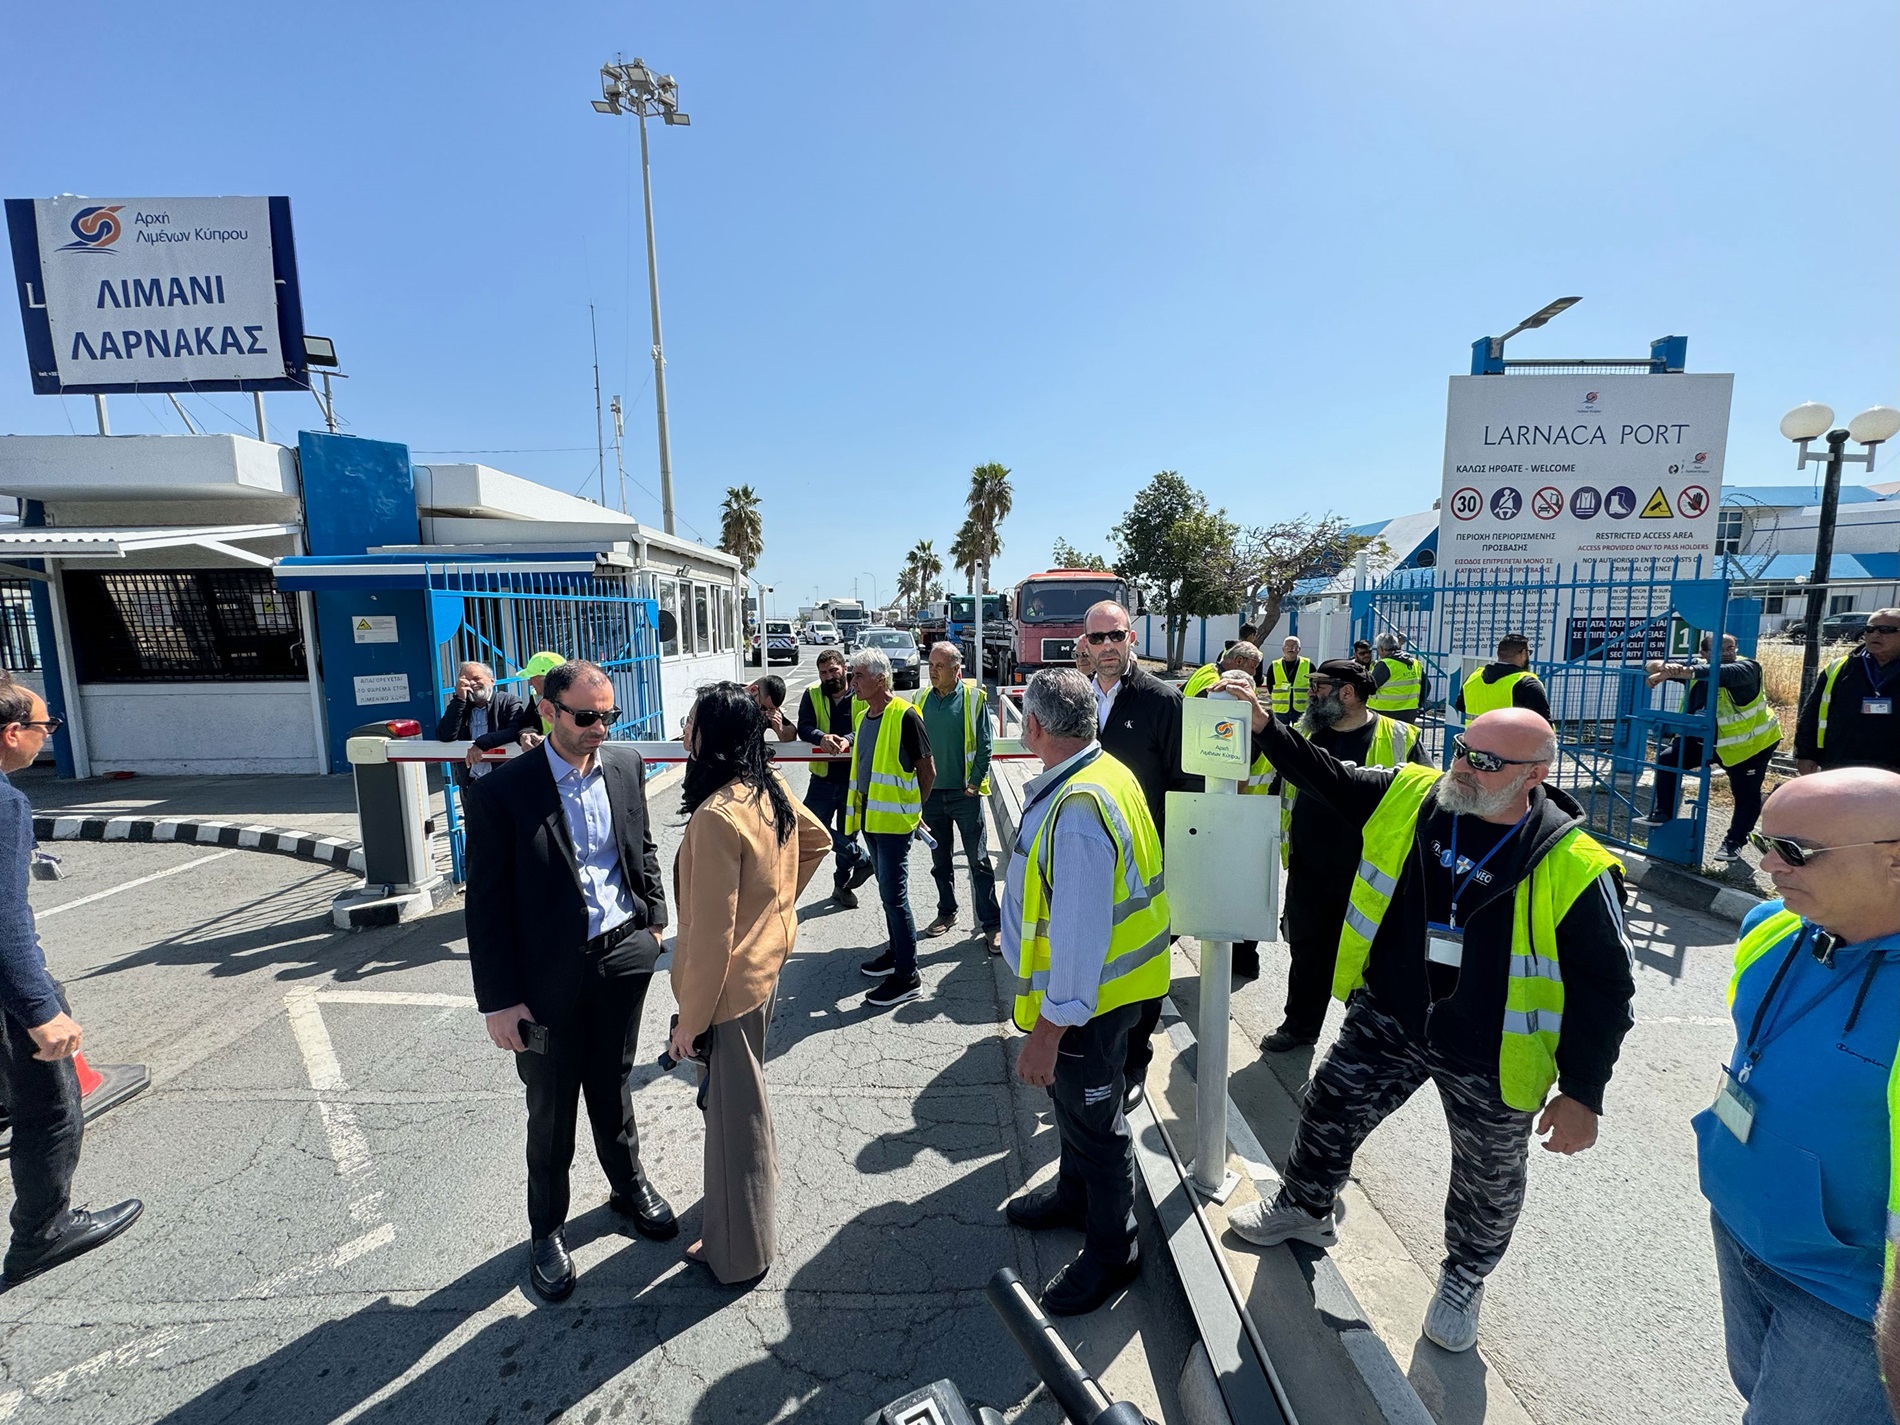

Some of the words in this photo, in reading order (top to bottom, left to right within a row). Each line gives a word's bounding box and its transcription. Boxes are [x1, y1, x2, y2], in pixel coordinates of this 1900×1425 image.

[134, 211, 170, 226] Αρχή
[136, 229, 190, 246] Λιμένων
[195, 228, 248, 244] Κύπρου
[97, 275, 225, 309] ΛΙΜΑΝΙ
[71, 325, 268, 360] ΛΑΡΝΑΚΑΣ
[1484, 425, 1607, 445] LARNACA
[1620, 424, 1690, 445] PORT
[1456, 464, 1486, 473] ΚΑΛΩΣ
[1488, 464, 1523, 473] ΗΡΘΑΤΕ
[1530, 464, 1576, 473] WELCOME
[1457, 495, 1477, 513] 30
[1456, 533, 1490, 541] ΠΕΡΙΟΧΗ
[1595, 532, 1641, 540] RESTRICTED
[1673, 531, 1693, 539] AREA
[1678, 627, 1690, 648] 1
